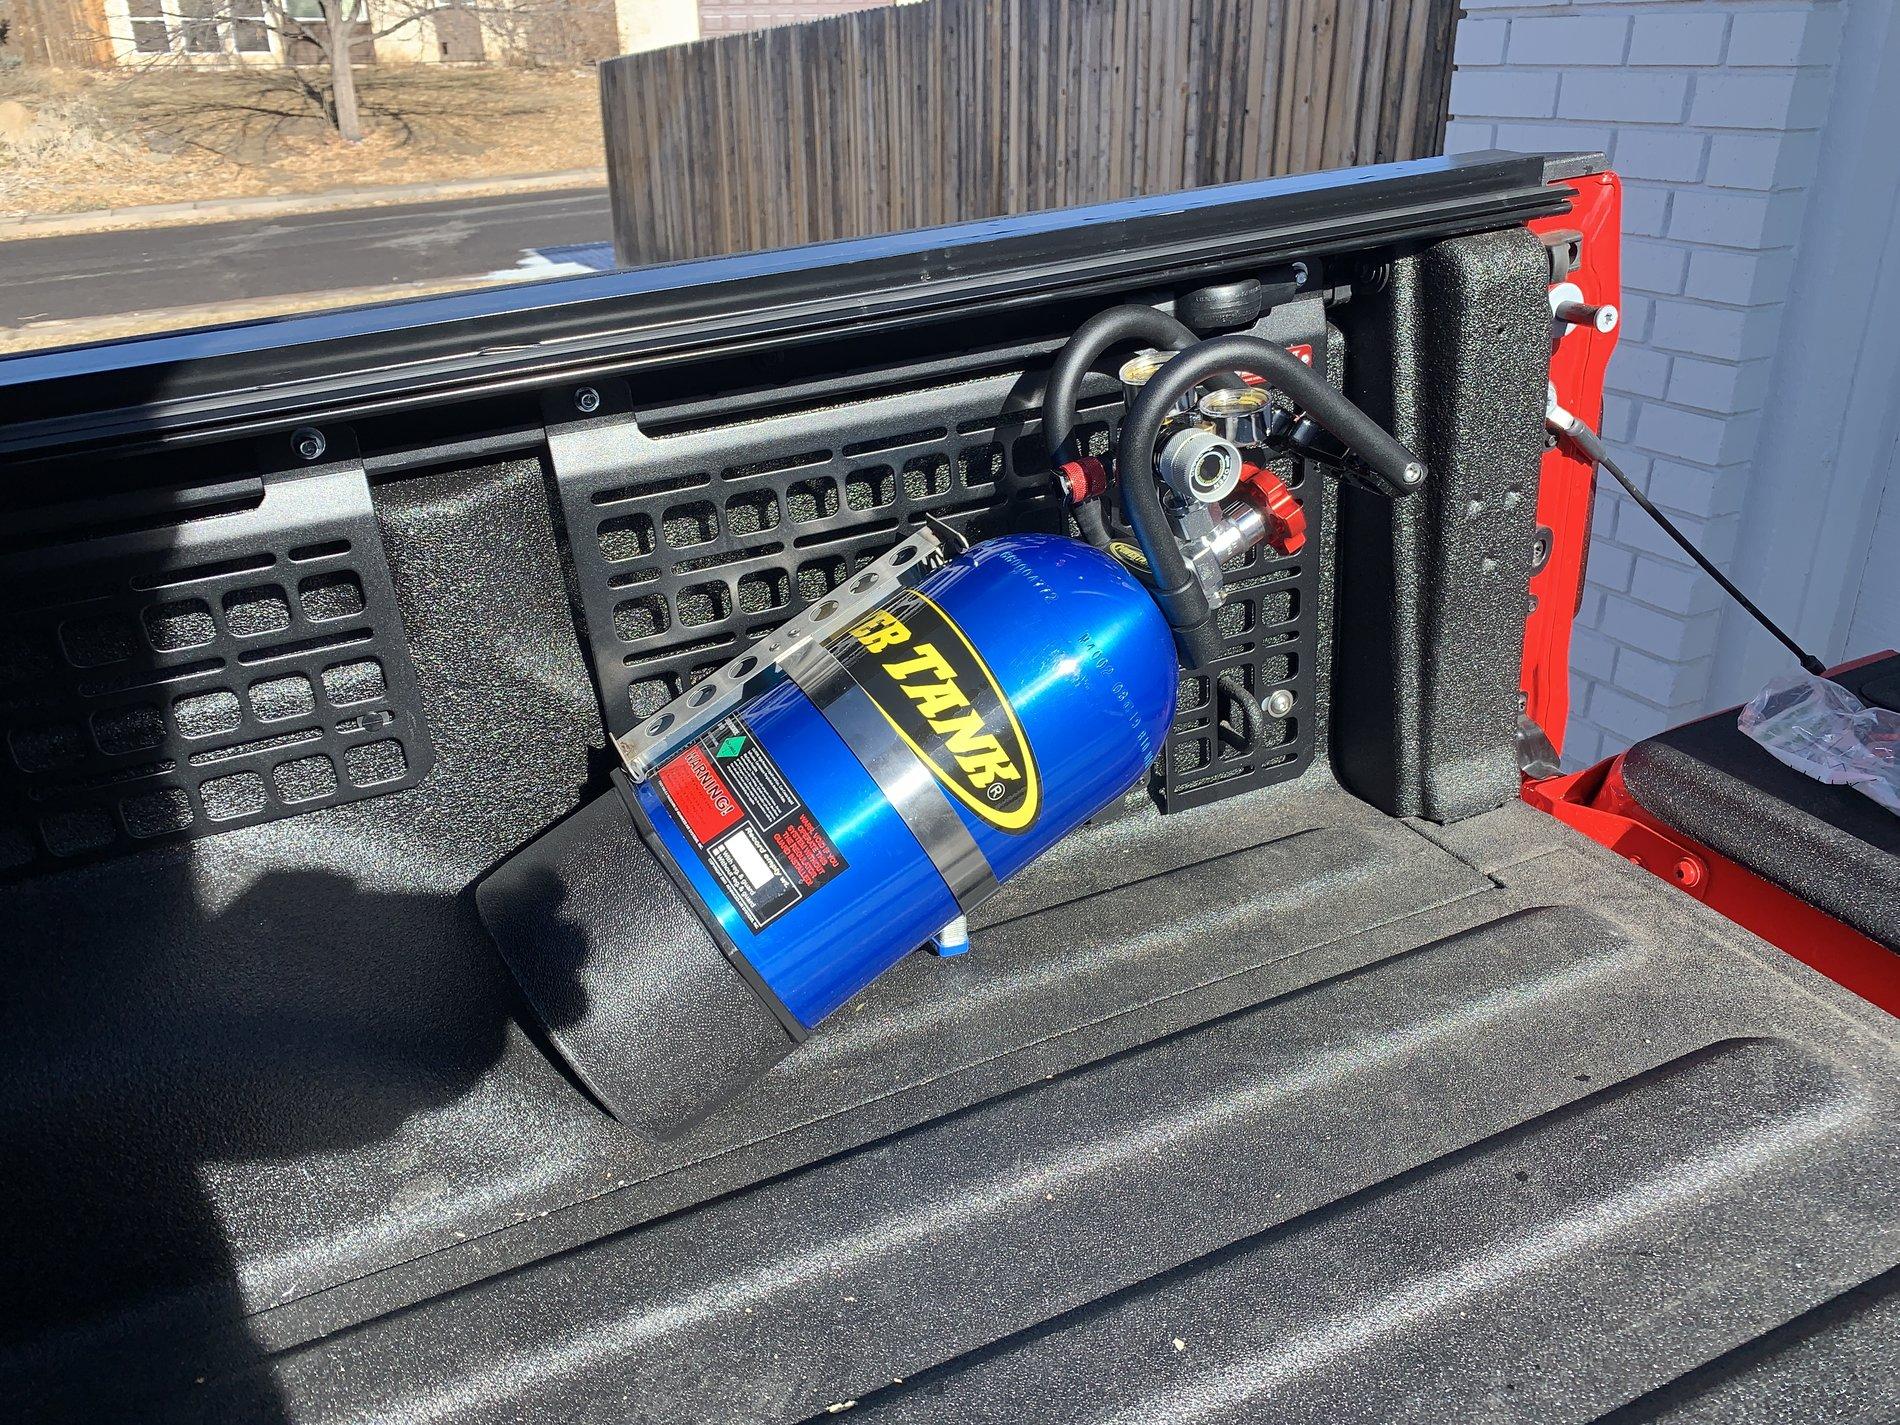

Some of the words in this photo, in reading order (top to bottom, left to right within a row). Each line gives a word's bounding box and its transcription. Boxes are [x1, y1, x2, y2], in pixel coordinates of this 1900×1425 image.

[681, 749, 736, 817] WARNING!
[744, 826, 767, 854] Record
[762, 852, 782, 877] empty
[779, 875, 791, 888] wt.
[772, 832, 791, 855] GUARD
[781, 831, 795, 847] THE
[790, 844, 817, 878] REGULATOR
[786, 824, 807, 850] SYSTEM
[801, 846, 825, 876] WITHOUT
[796, 824, 819, 853] OPERATE
[813, 849, 828, 866] THIS
[811, 832, 825, 848] VOID
[824, 851, 839, 868] YOU
[715, 853, 734, 876] Without
[740, 890, 756, 908] guard
[721, 849, 734, 865] With
[739, 877, 756, 896] guard
